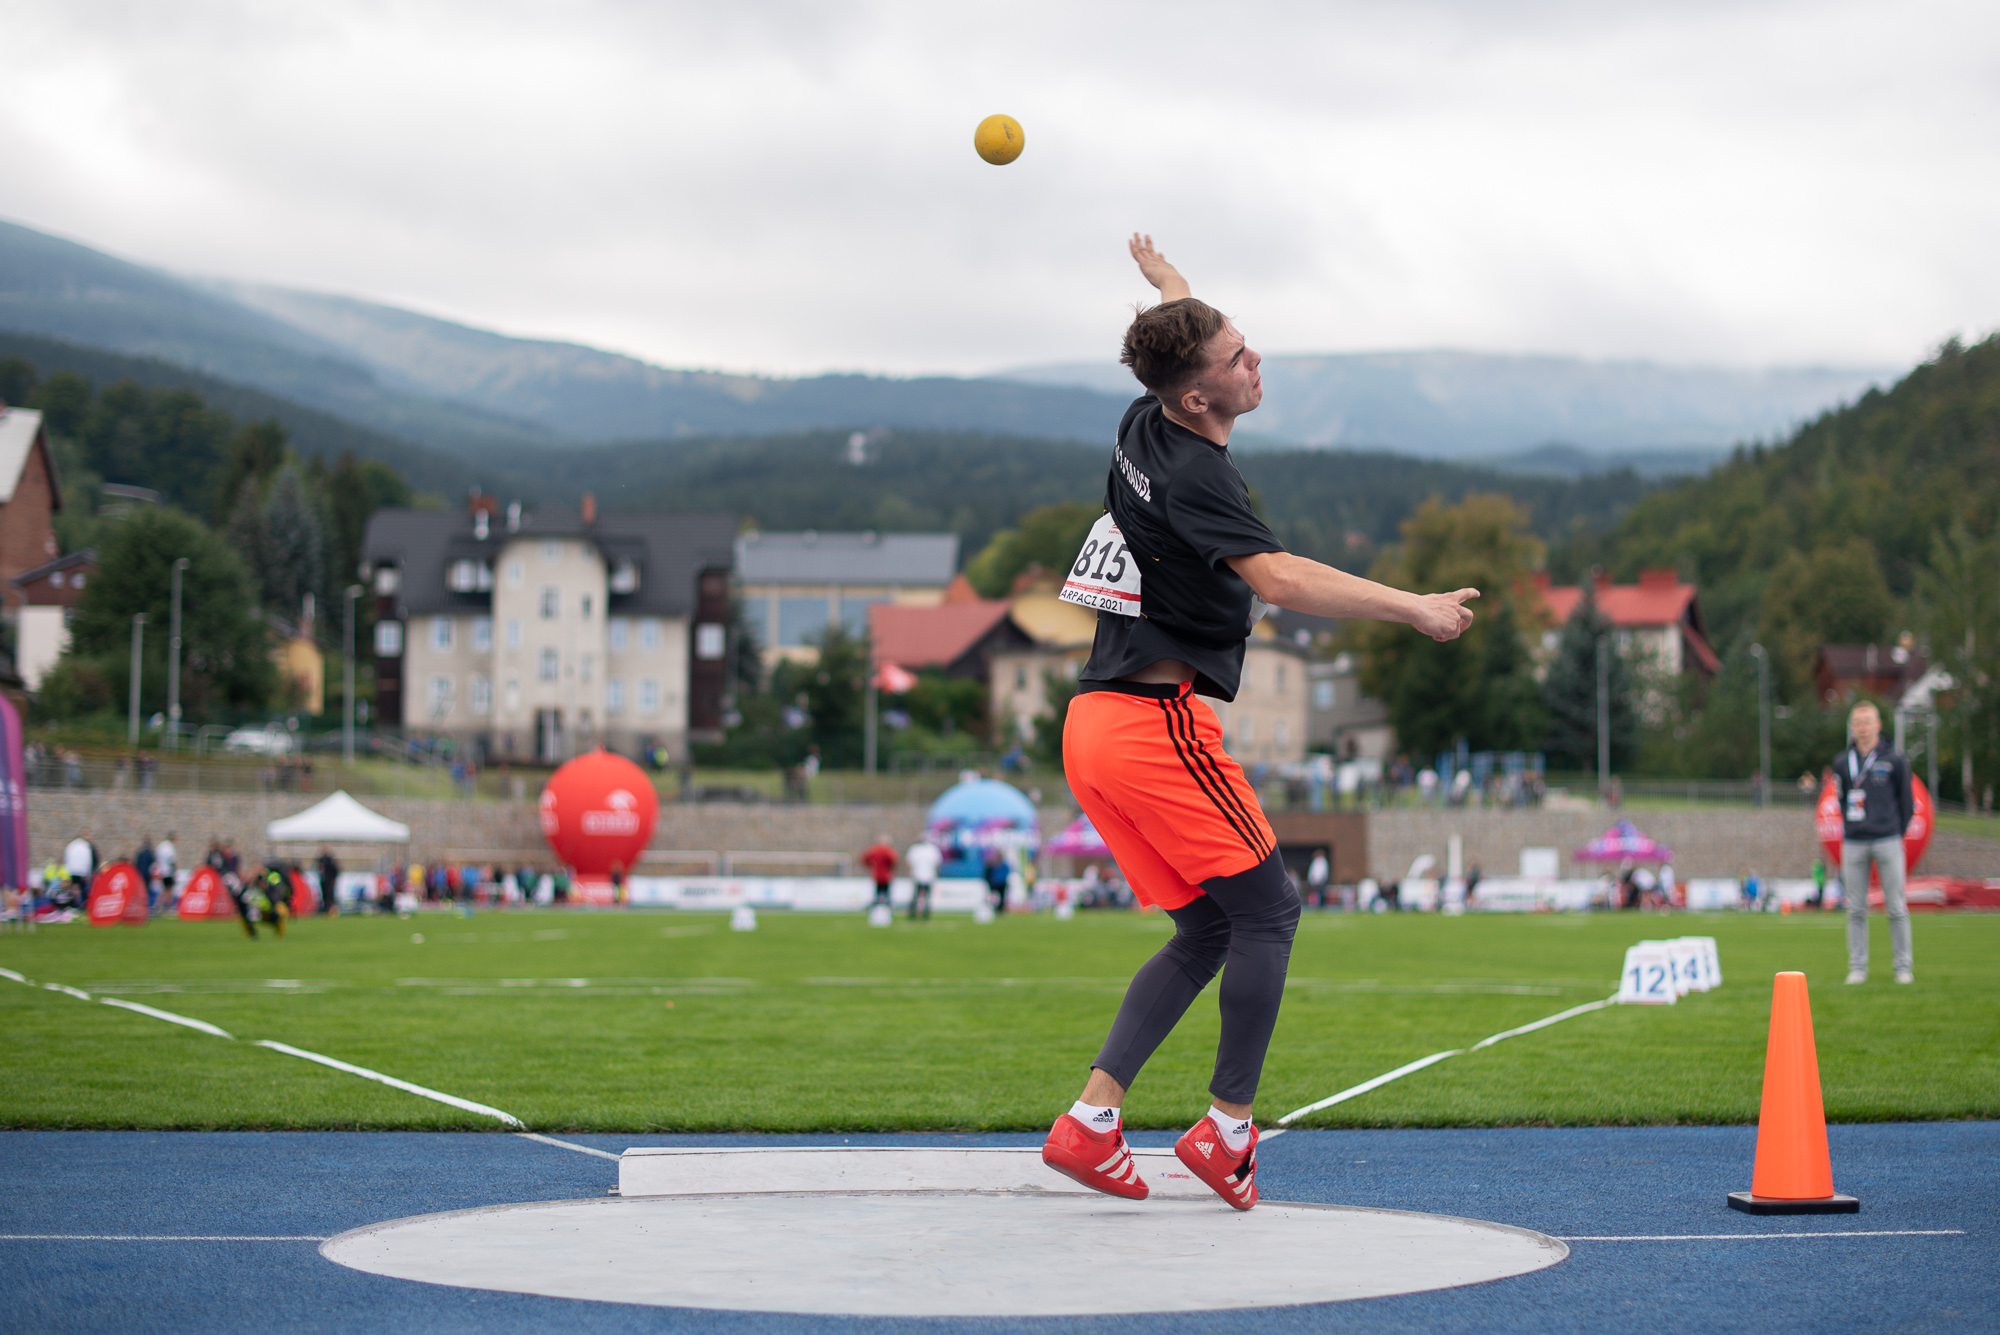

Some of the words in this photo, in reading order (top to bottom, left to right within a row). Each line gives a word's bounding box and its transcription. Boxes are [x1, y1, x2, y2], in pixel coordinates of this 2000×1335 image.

[1073, 539, 1130, 583] 815
[1061, 589, 1098, 607] ARPACZ
[1100, 597, 1123, 612] 2021
[1628, 965, 1666, 993] 12
[1195, 1141, 1211, 1160] adidas
